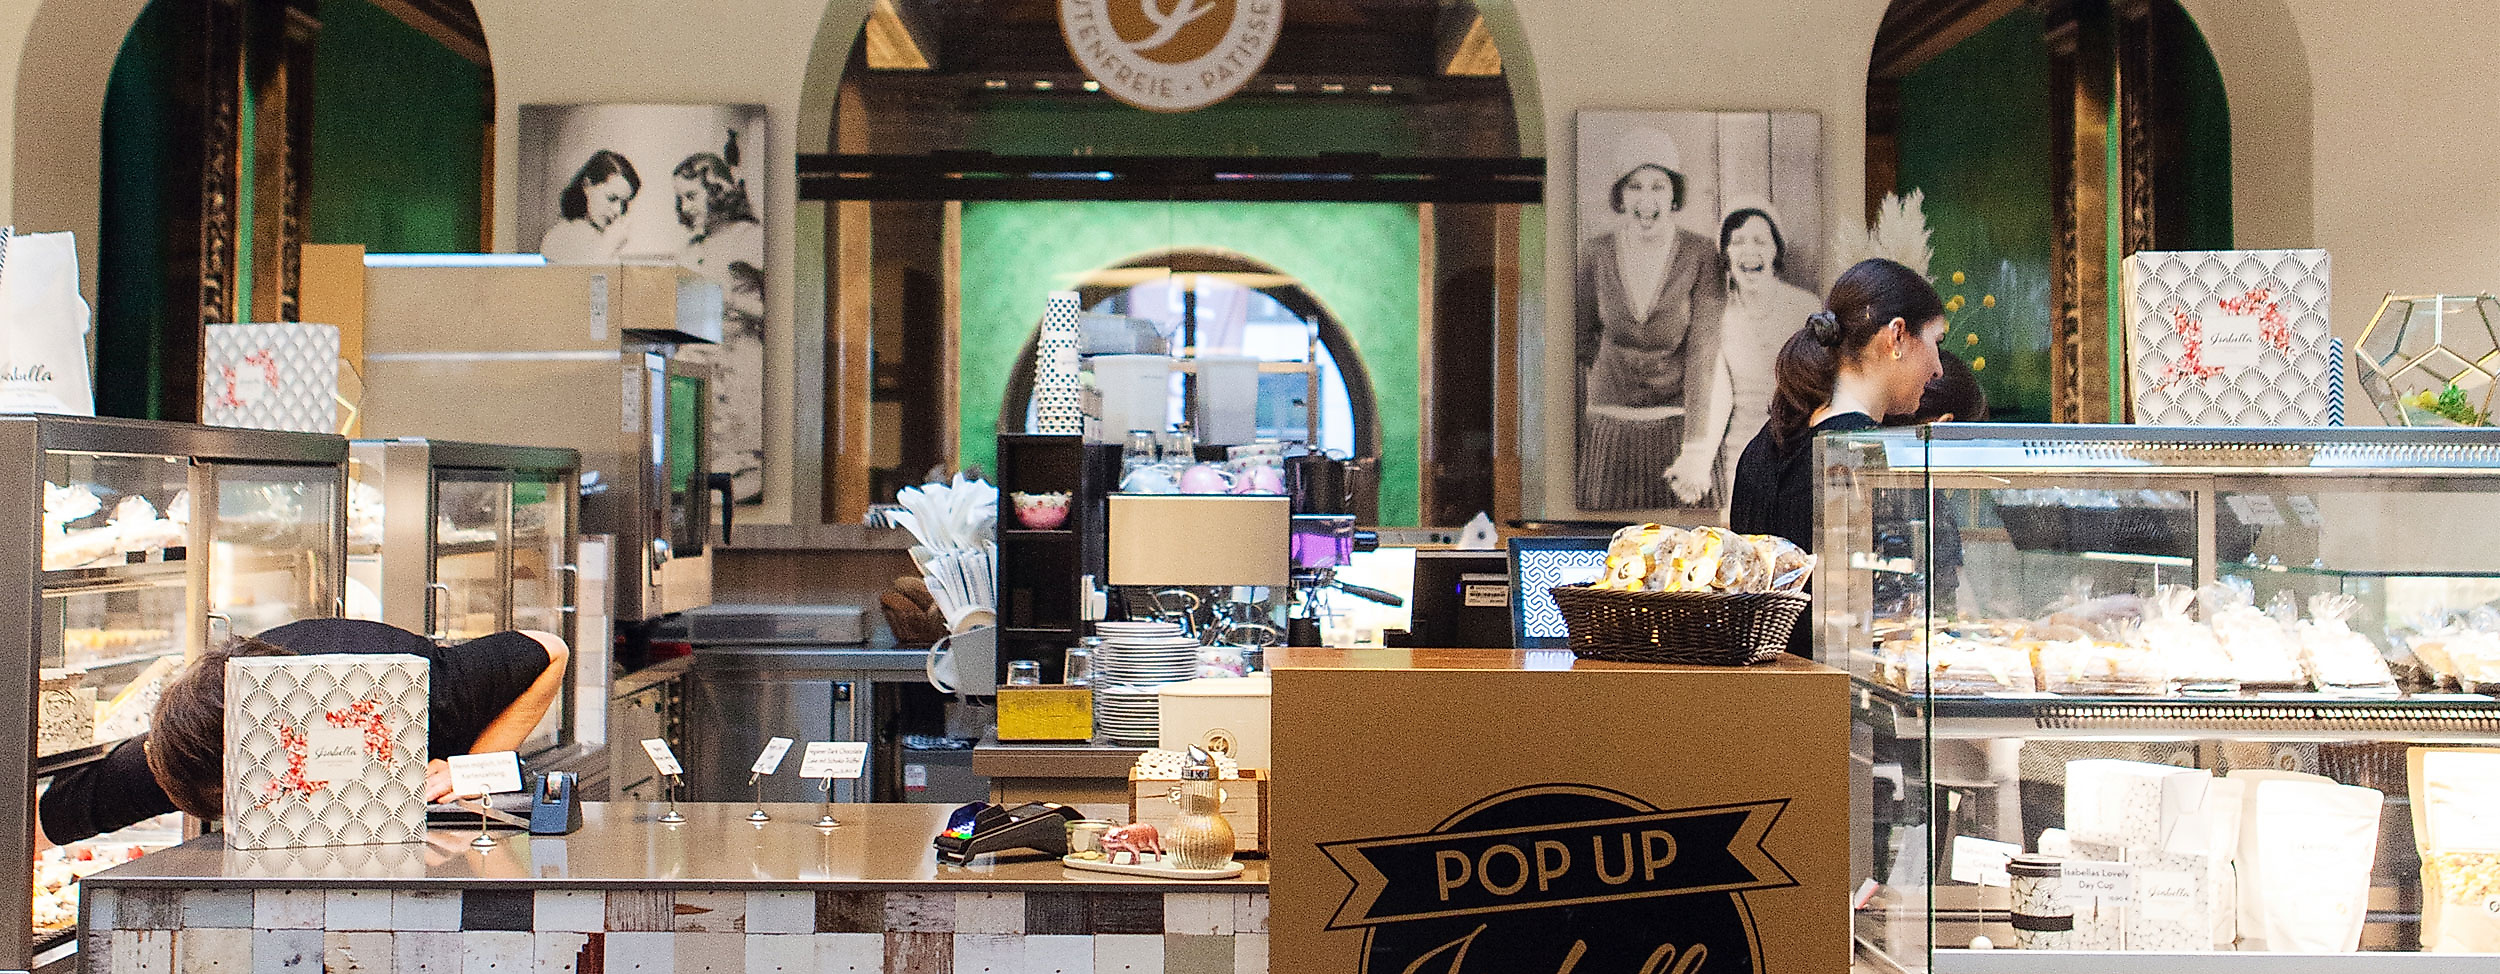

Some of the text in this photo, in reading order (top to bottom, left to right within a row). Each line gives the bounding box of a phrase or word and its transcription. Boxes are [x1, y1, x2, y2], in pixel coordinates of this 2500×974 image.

[1435, 829, 1678, 901] POP UP
[2064, 868, 2129, 879] Isabellas Lovely
[2078, 880, 2115, 890] Day Cup
